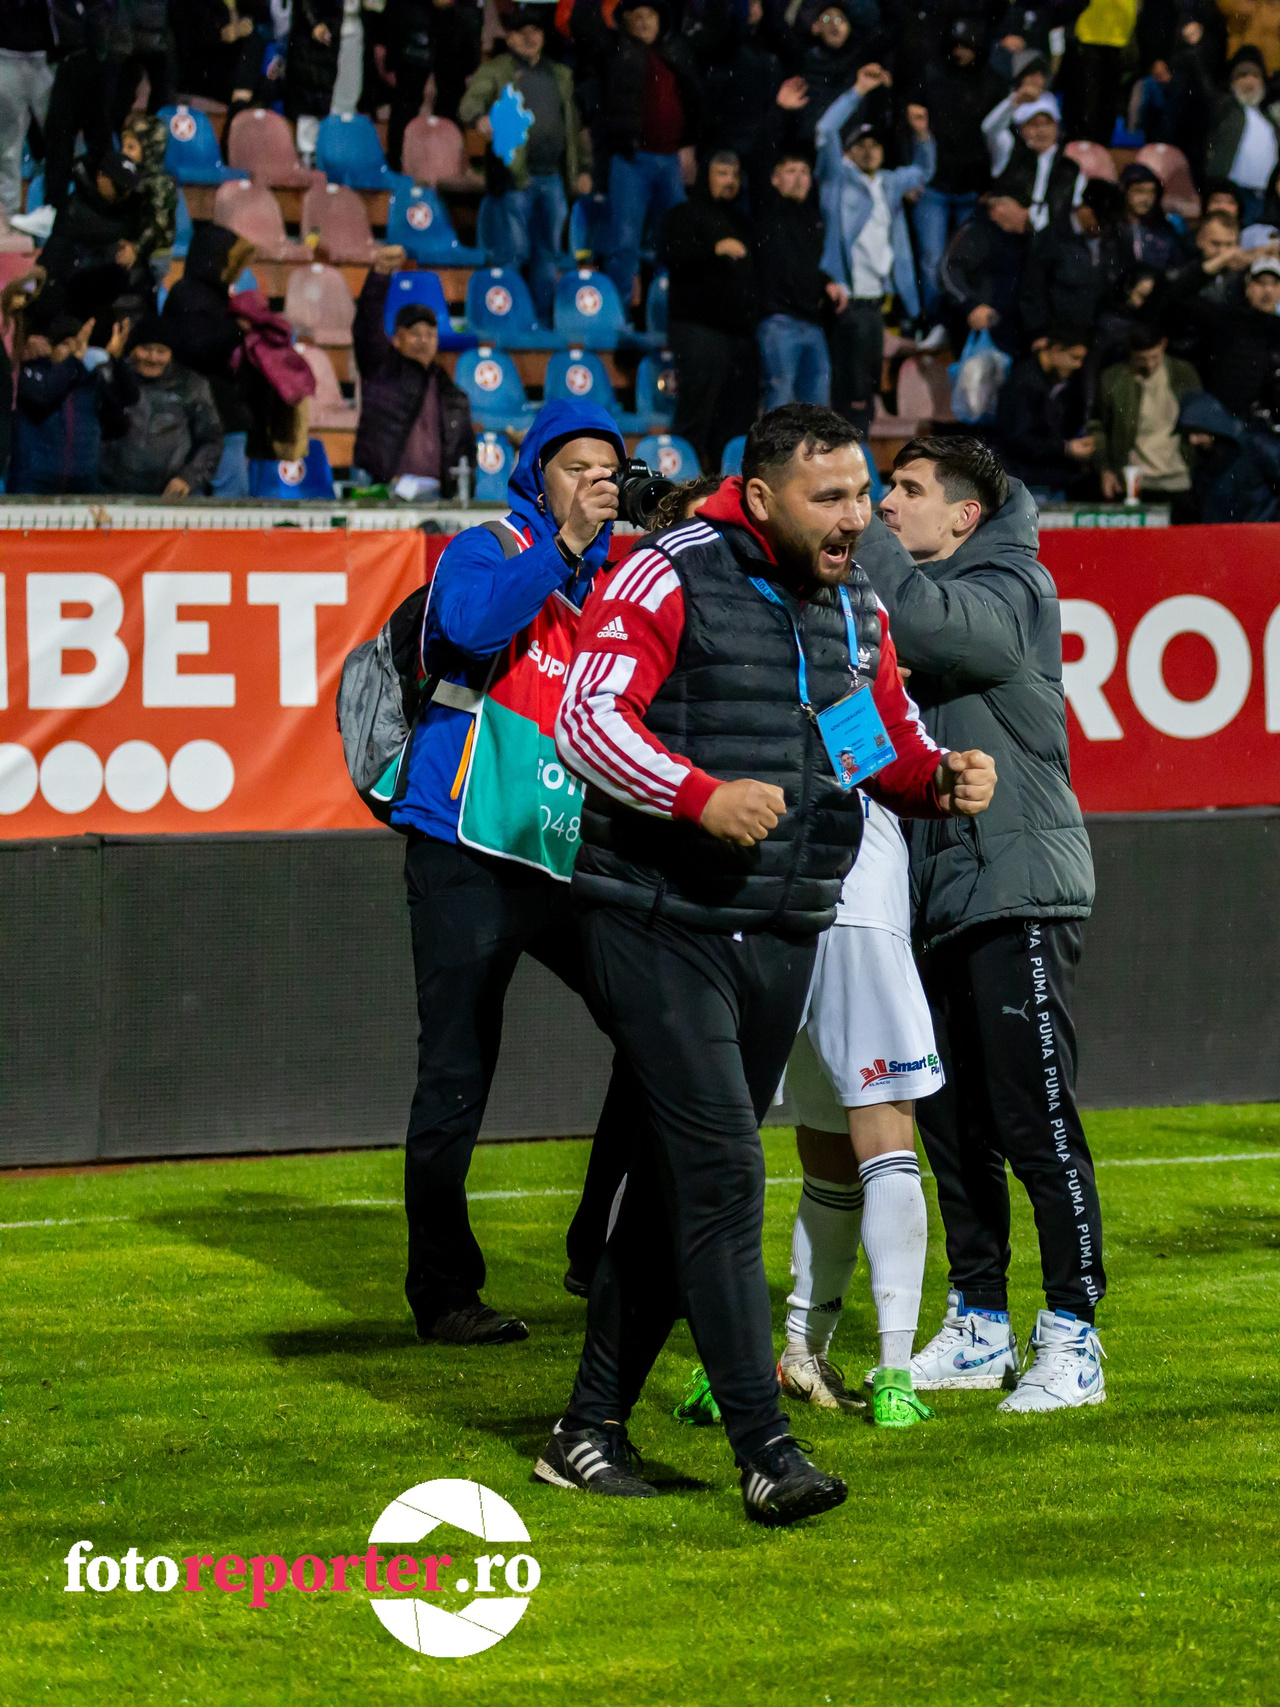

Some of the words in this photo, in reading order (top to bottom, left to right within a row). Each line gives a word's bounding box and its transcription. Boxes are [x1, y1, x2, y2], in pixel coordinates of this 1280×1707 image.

[0, 572, 348, 709] BET
[597, 631, 628, 640] adidas
[1030, 957, 1048, 1005] PUMA
[1037, 1011, 1054, 1060] PUMA
[1044, 1066, 1062, 1112] PUMA
[1050, 1118, 1070, 1163] PUMA
[1066, 1169, 1085, 1217] PUMA
[1077, 1223, 1094, 1270] PUMA
